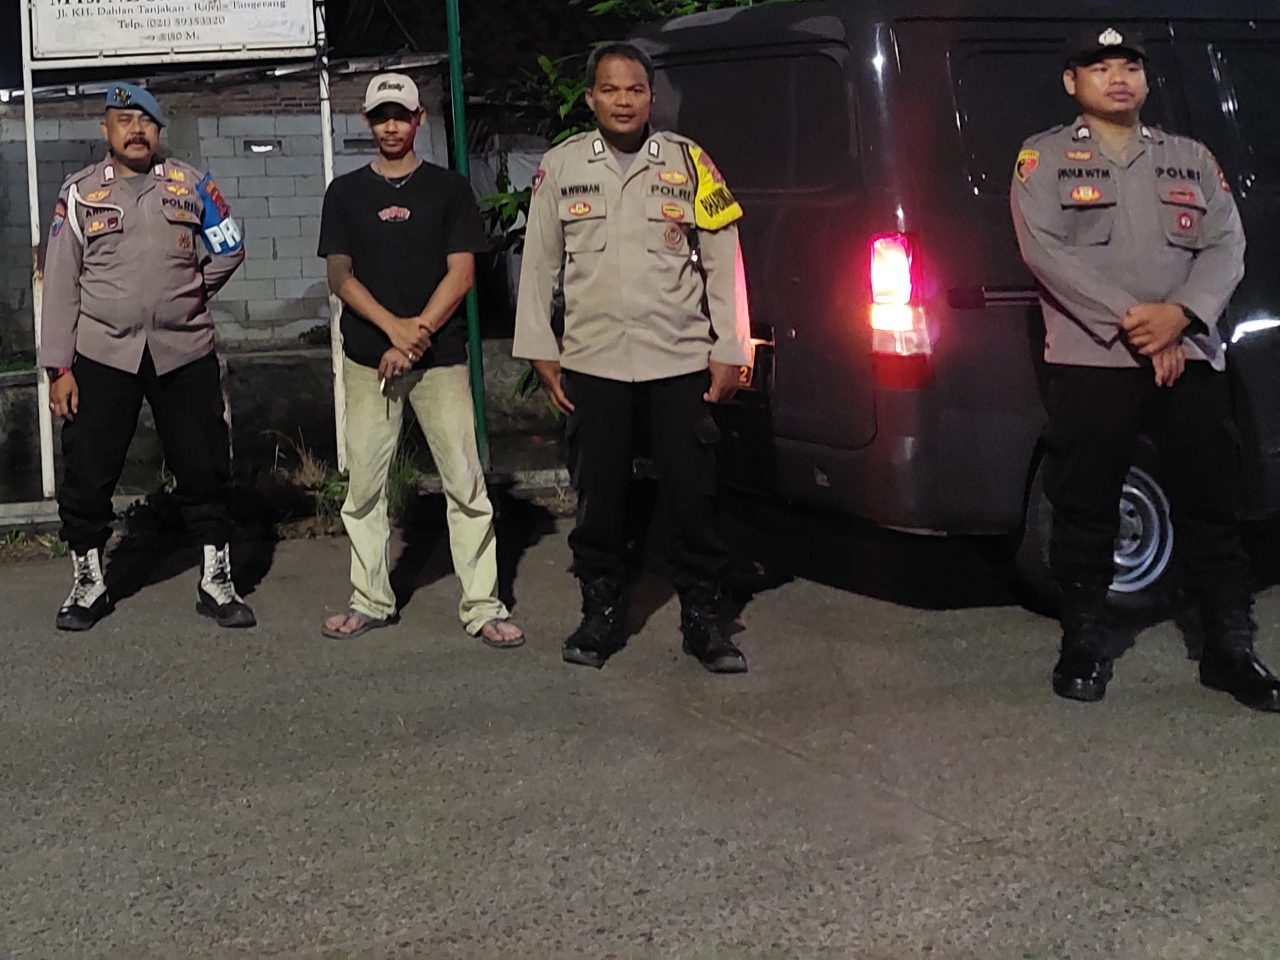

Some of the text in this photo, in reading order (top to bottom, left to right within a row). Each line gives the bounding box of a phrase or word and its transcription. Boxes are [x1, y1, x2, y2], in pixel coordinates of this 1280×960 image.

[72, 8, 94, 18] KH.
[97, 6, 134, 16] Dahlan
[137, 4, 185, 15] Tanjakan
[117, 20, 144, 30] Telp.
[1155, 167, 1201, 182] POLRI
[651, 185, 692, 202] POLRI
[161, 197, 197, 212] POLRI
